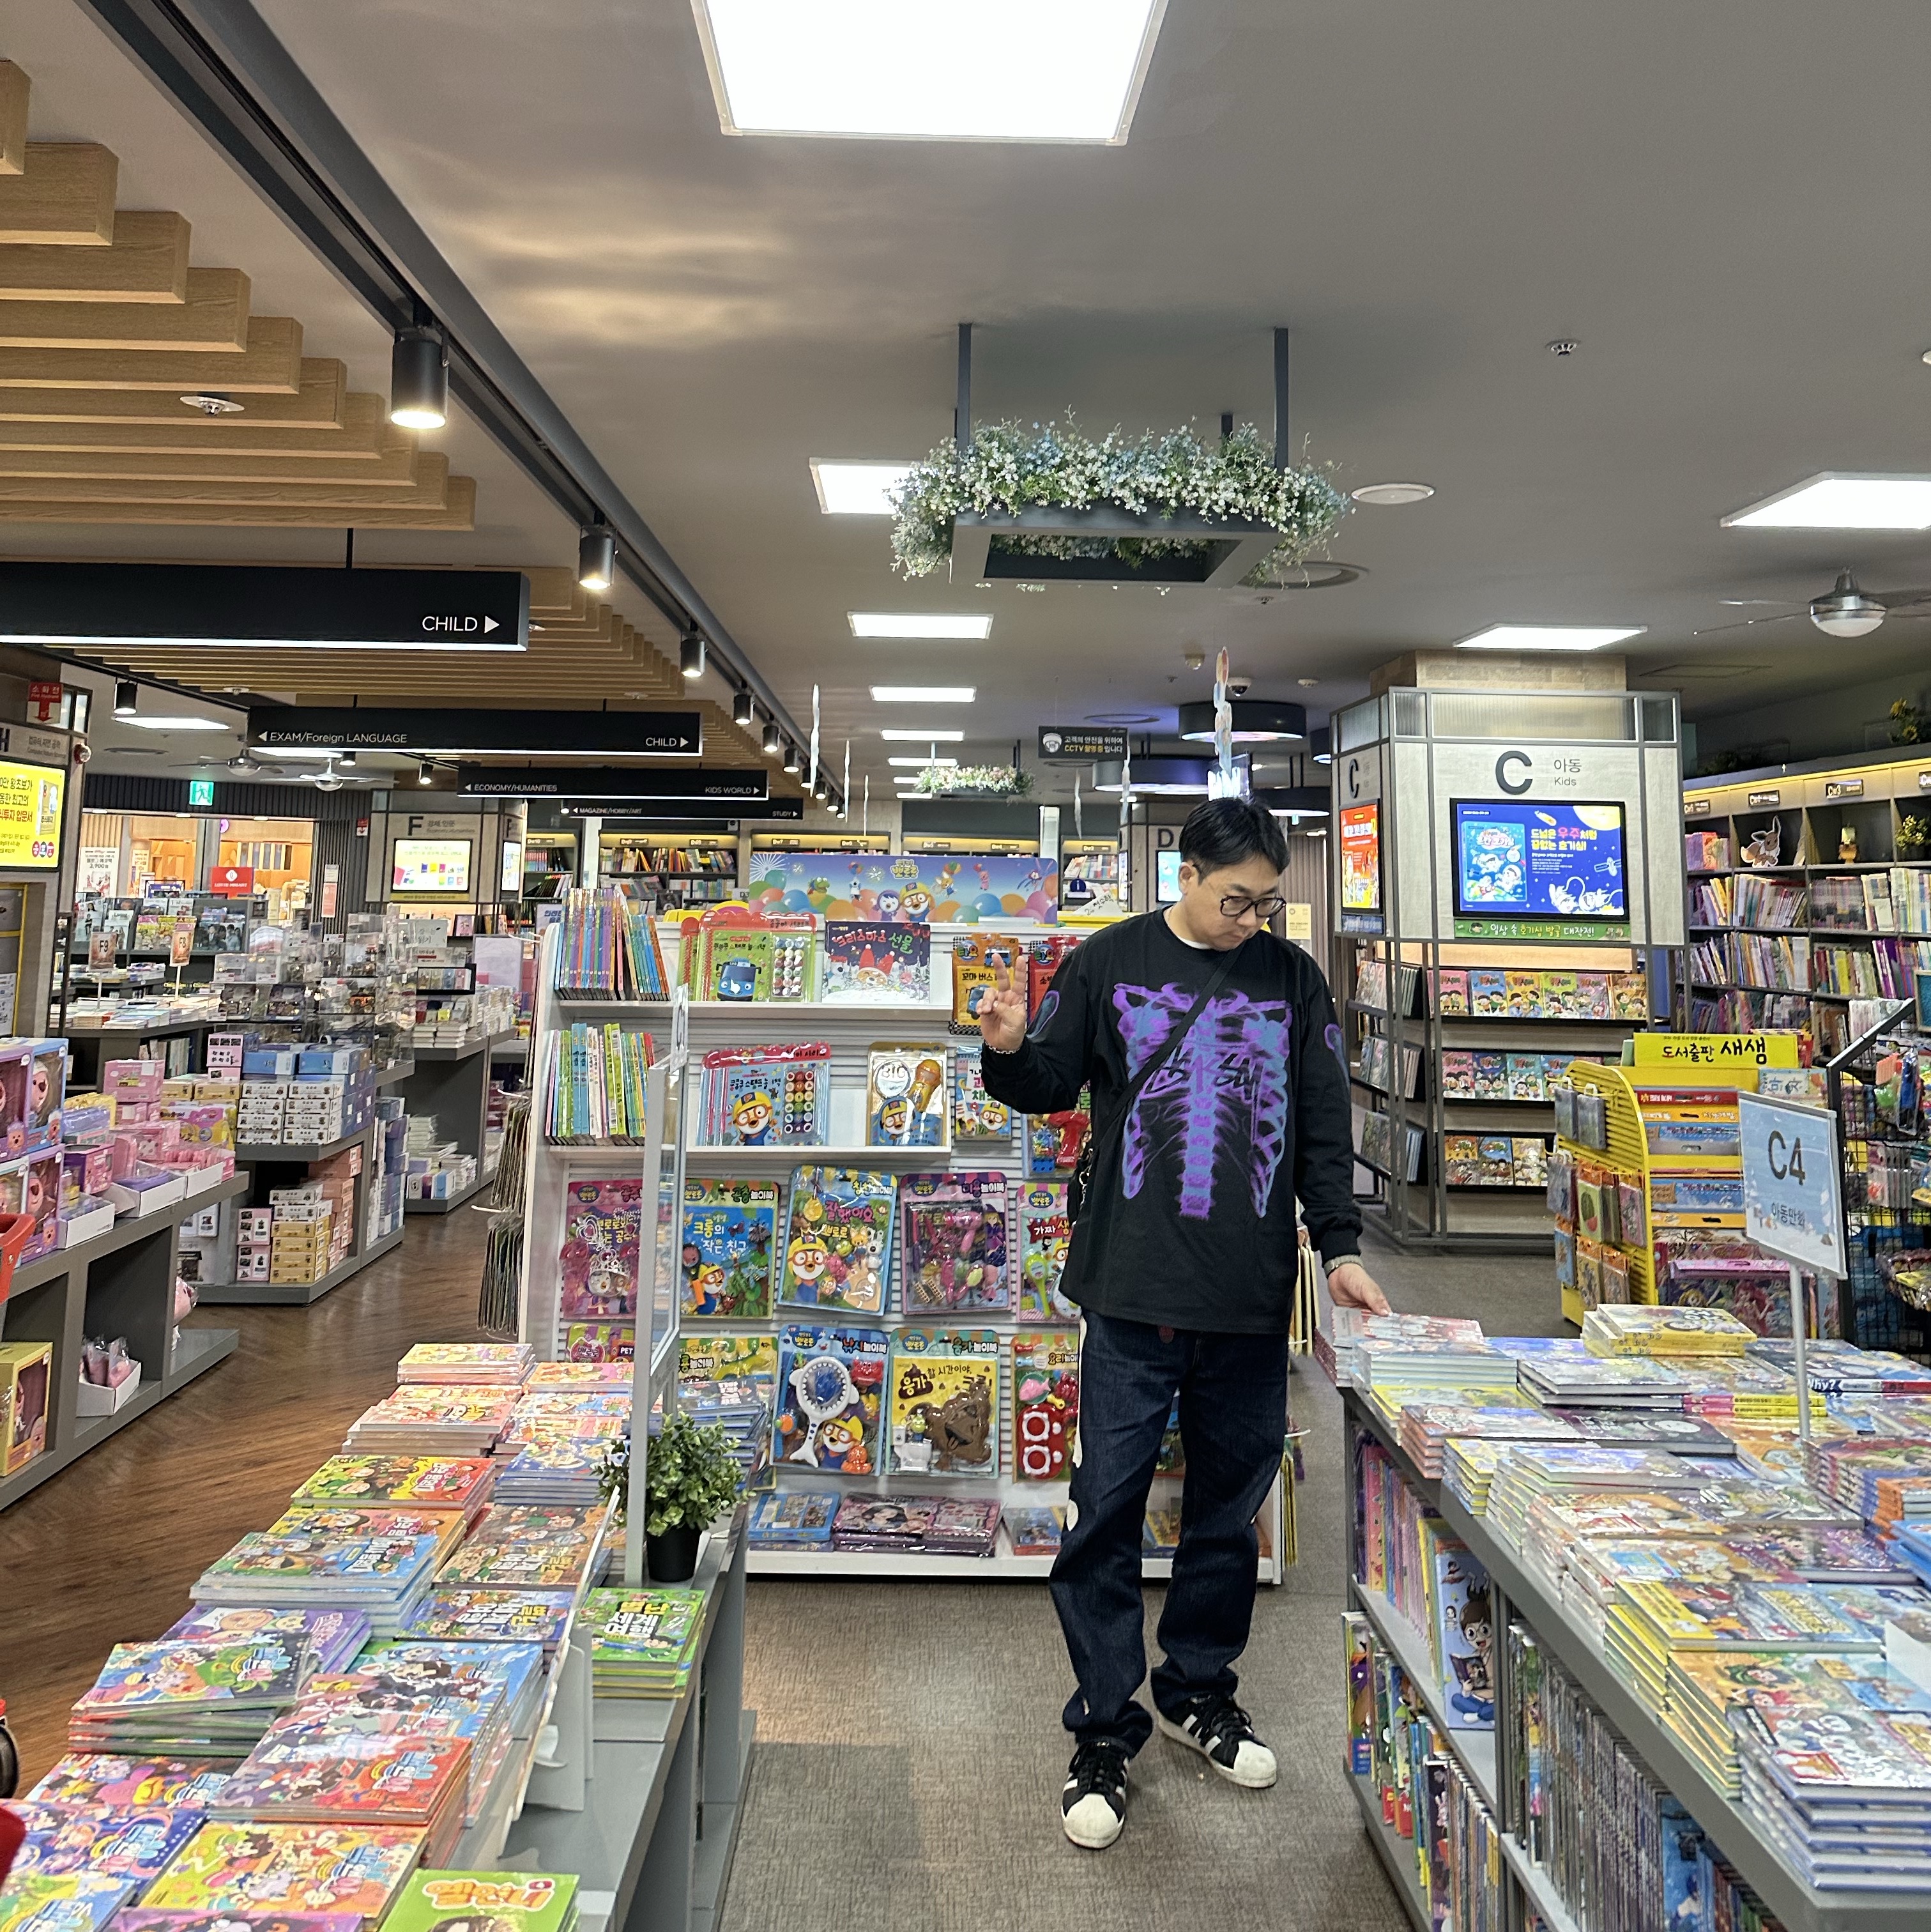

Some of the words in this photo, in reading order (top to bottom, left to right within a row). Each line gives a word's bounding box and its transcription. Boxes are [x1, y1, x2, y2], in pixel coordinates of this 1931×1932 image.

[422, 616, 478, 632] CHILD
[270, 732, 344, 743] EXAM/Foreign
[347, 733, 408, 743] LANGUAGE
[645, 737, 677, 747] CHILD
[1495, 750, 1533, 795] C
[1553, 758, 1582, 773] 아동
[1348, 758, 1359, 799] C
[1553, 776, 1577, 786] Kids
[474, 784, 557, 792] ECONOMY/HUMANITIES
[12, 795, 29, 807] 최고의
[16, 811, 33, 823] 입문서
[408, 816, 424, 836] F
[1157, 829, 1173, 848] D
[1557, 827, 1598, 840] 우주처럼
[1558, 840, 1587, 852] 호기심!
[1490, 923, 1508, 935] 일상
[1520, 924, 1543, 937] 호기심
[1545, 924, 1561, 938] 발굴
[1563, 926, 1595, 937] 대작전!
[98, 940, 109, 953] F9
[178, 937, 187, 949] F8
[832, 928, 887, 947] 크리스마스
[888, 931, 913, 954] 선물
[957, 944, 979, 957] 타요
[1034, 949, 1055, 961] 타요
[962, 973, 977, 981] 꼬마
[979, 972, 993, 981] 버스
[1662, 1042, 1715, 1063] 도서출판
[1720, 1036, 1767, 1065] 새샘
[881, 1064, 906, 1078] BIG
[1767, 1130, 1806, 1186] C4
[825, 1200, 876, 1224] 잘했어요
[693, 1220, 724, 1238] 크롱의
[821, 1224, 848, 1238] 뽀로로
[1034, 1225, 1056, 1234] 가짜
[726, 1241, 747, 1254] 친구
[794, 1337, 814, 1347] 뽀로로
[904, 1340, 926, 1351] 뽀로로
[620, 1347, 634, 1355] PET
[903, 1374, 927, 1396] 응가
[1807, 1378, 1836, 1392] Why?
[620, 1601, 669, 1615] 별난
[512, 1606, 547, 1627] 별난
[607, 1611, 659, 1627] 세계
[604, 1623, 655, 1638] 여행
